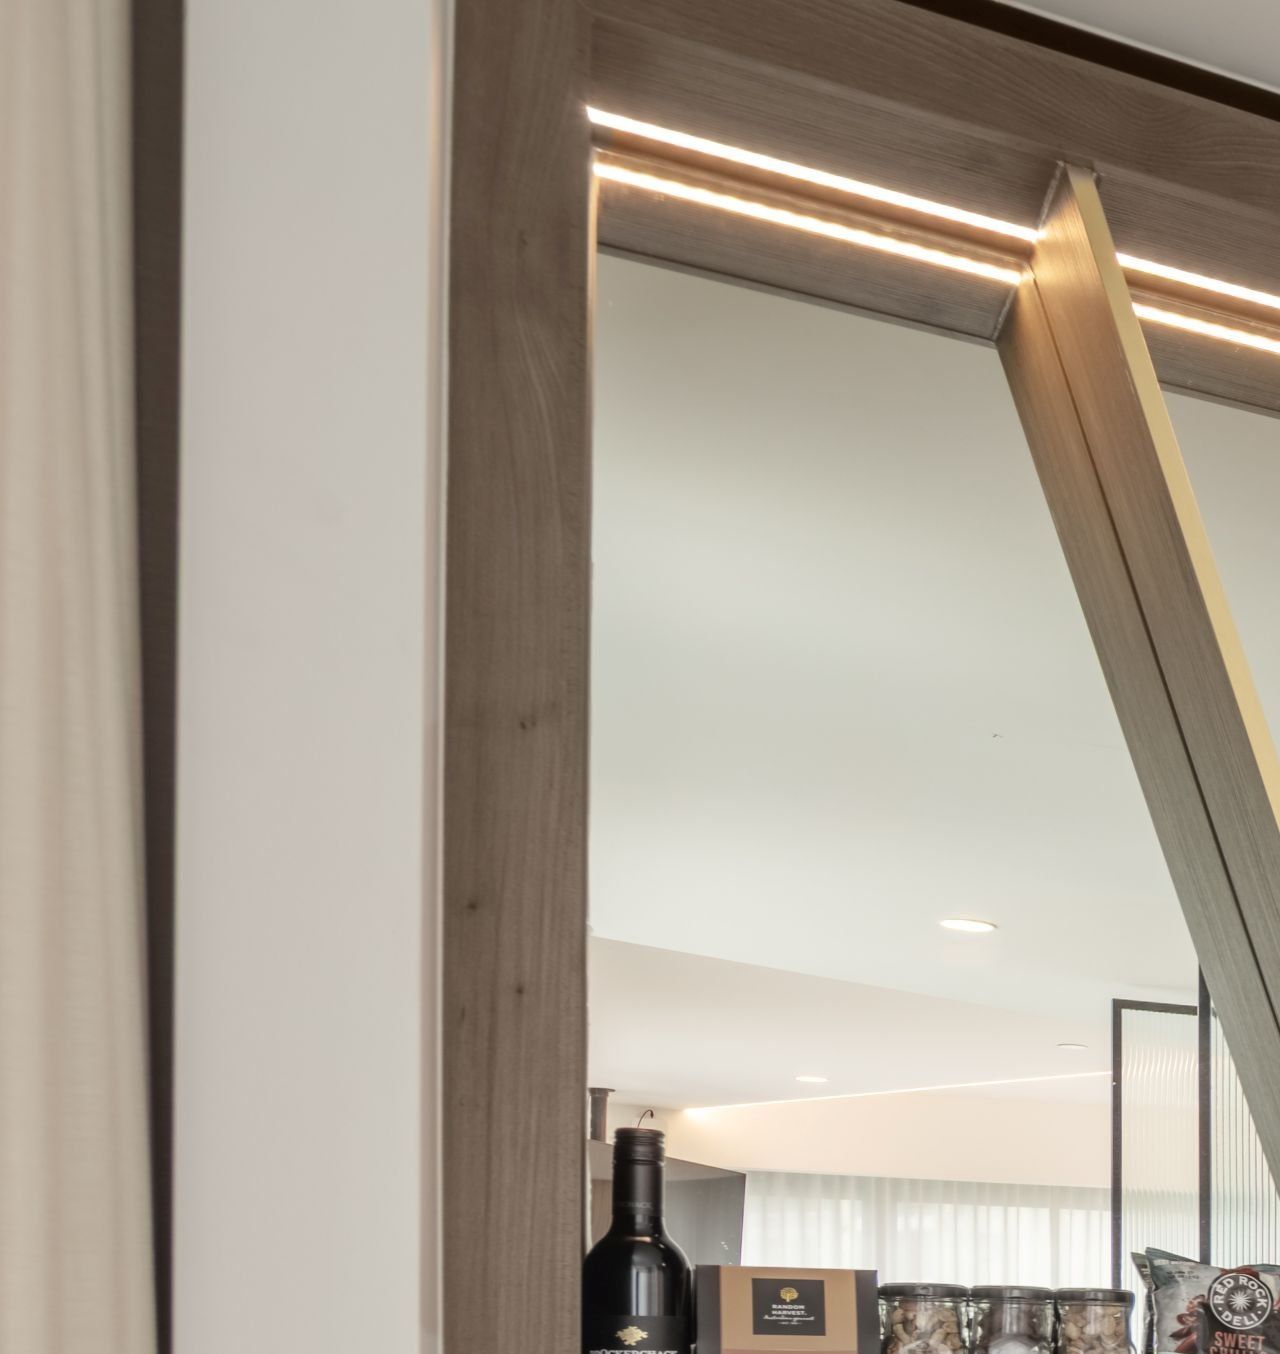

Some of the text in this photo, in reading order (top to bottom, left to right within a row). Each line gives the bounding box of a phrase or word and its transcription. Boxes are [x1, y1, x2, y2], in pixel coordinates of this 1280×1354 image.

[1213, 1276, 1268, 1308] RED ROCK
[1221, 1311, 1259, 1326] DELI
[1214, 1331, 1266, 1350] SWEET
